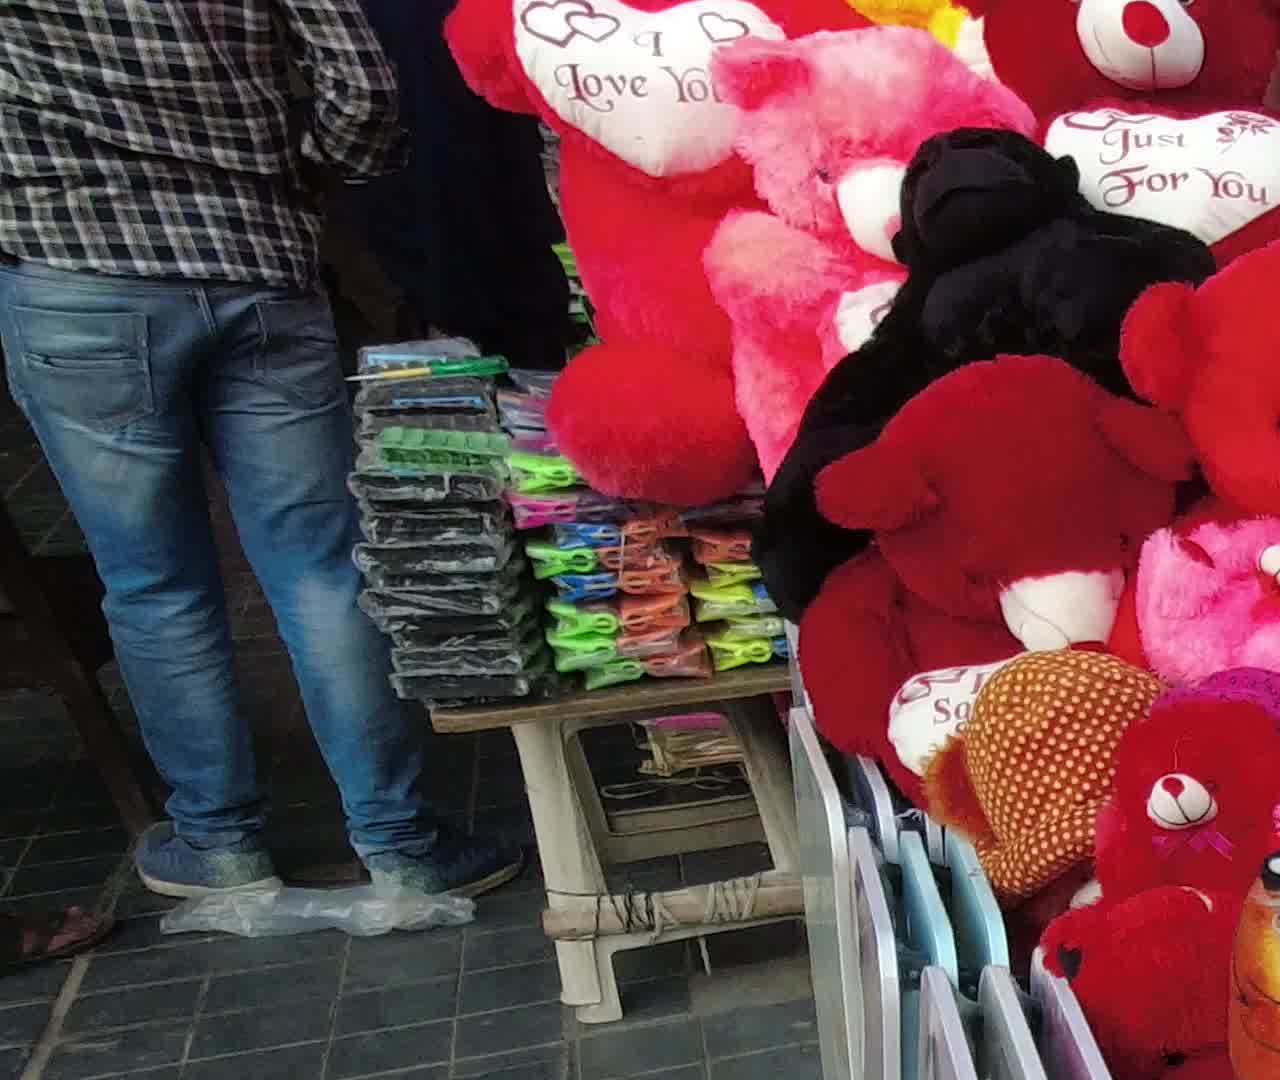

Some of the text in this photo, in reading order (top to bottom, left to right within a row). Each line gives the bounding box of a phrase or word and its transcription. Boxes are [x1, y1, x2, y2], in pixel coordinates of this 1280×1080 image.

[633, 31, 664, 57] I
[554, 63, 648, 112] Love
[1099, 128, 1186, 165] Just
[1099, 164, 1270, 207] For You
